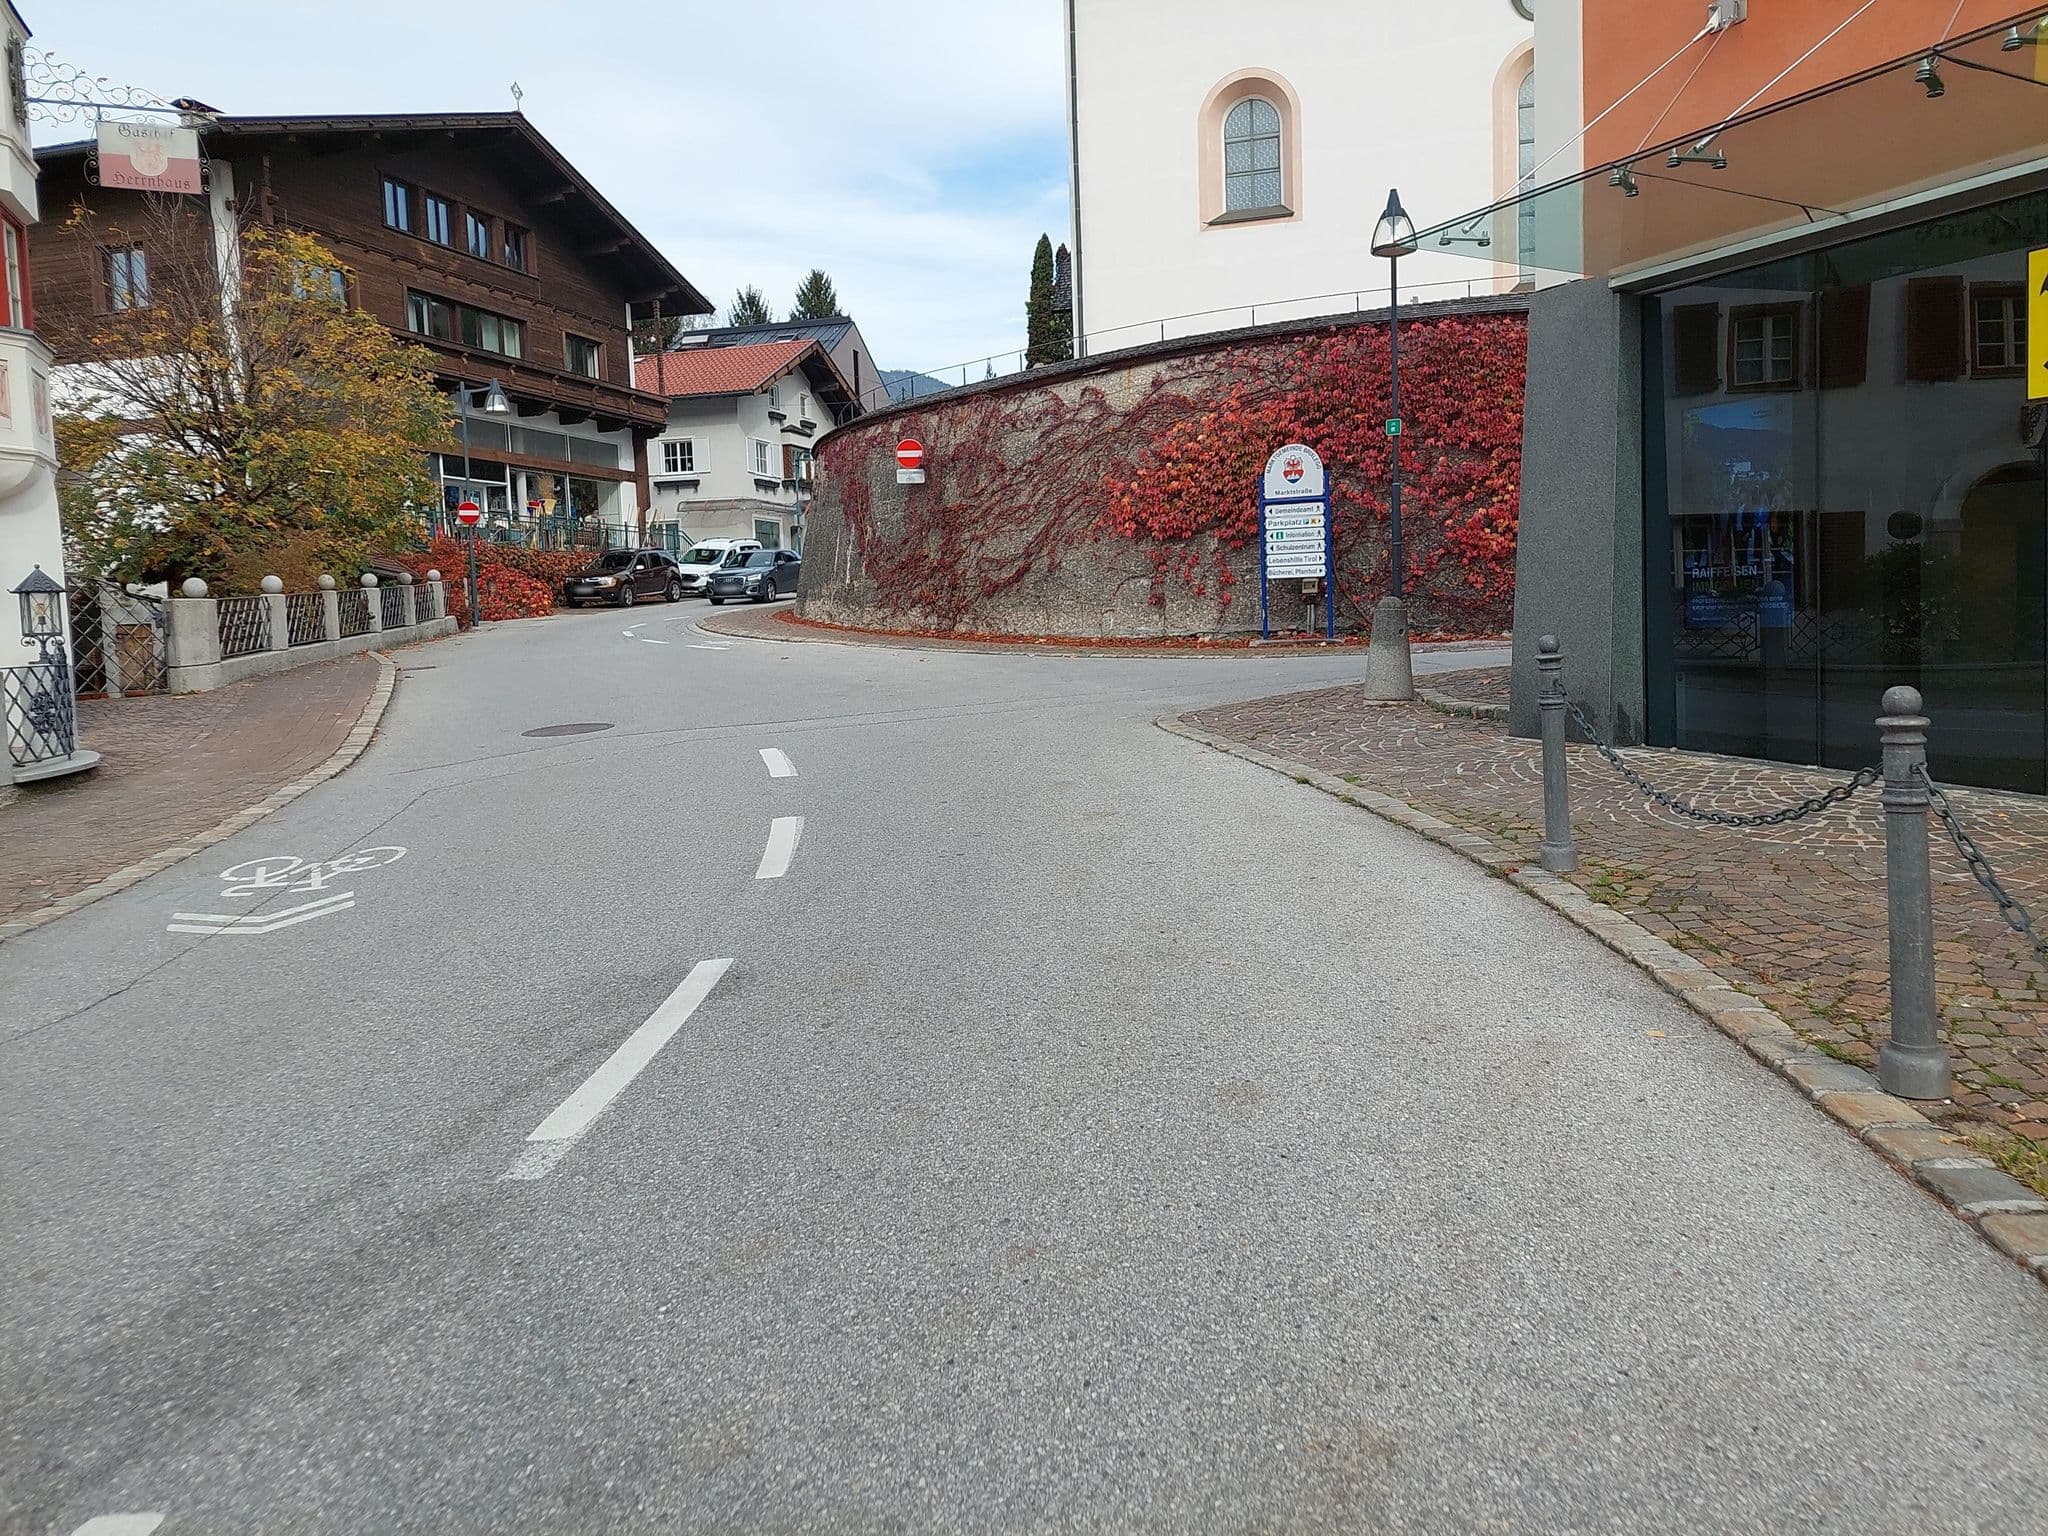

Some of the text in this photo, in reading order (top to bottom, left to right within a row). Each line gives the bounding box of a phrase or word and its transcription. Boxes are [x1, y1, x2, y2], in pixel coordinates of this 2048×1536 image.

[118, 123, 175, 138] Gasthf
[112, 171, 191, 189] Herrnhaus
[1275, 488, 1313, 496] Marktstraße
[1275, 506, 1314, 514] Gemeindeamt
[1268, 519, 1302, 527] Parkplatz
[1304, 555, 1317, 563] Tirol
